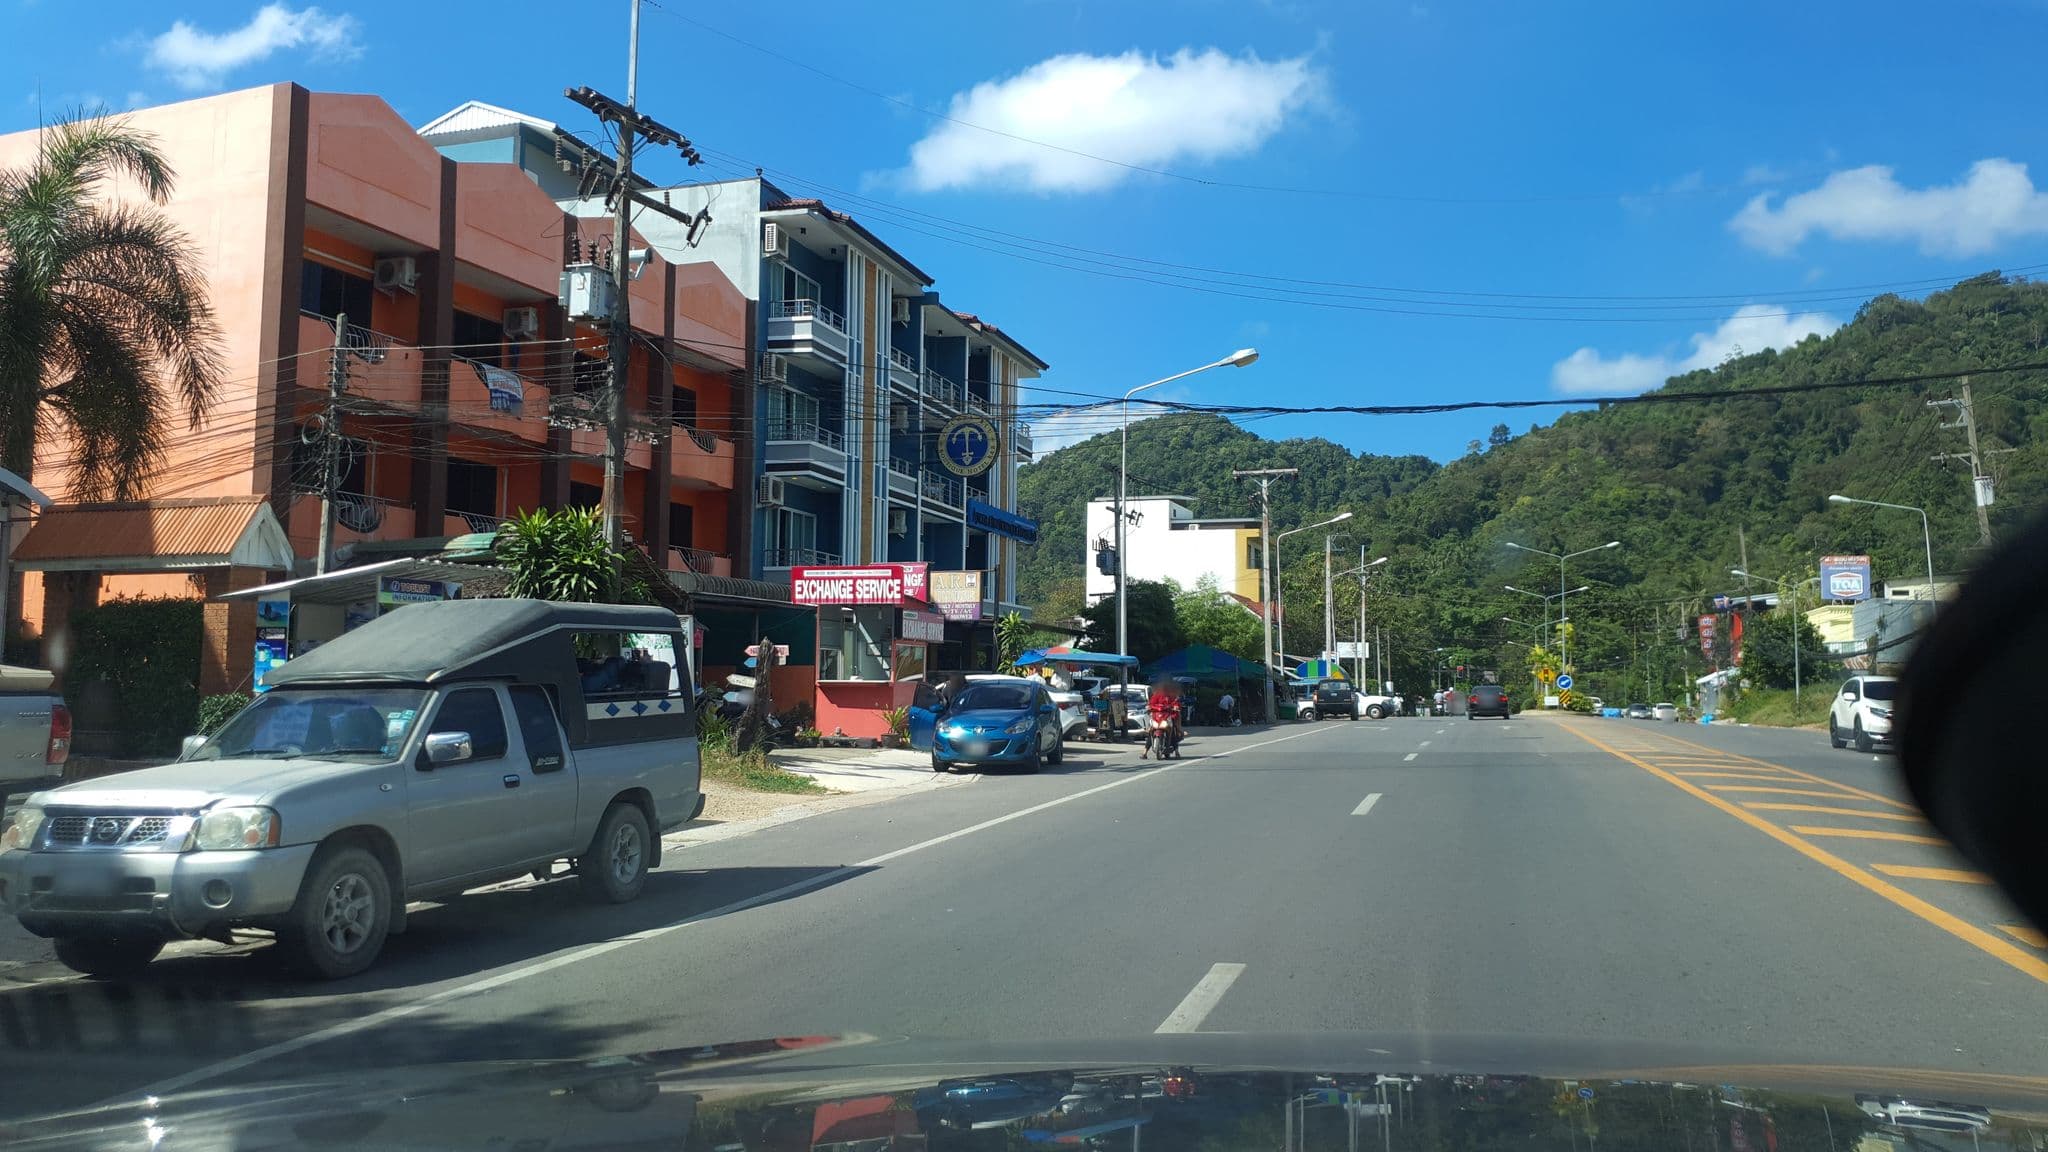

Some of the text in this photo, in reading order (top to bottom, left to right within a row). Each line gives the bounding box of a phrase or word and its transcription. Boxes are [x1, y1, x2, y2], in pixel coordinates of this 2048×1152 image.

[967, 461, 989, 474] HOTEL
[400, 582, 431, 593] TOURIST
[795, 579, 901, 600] EXCHANGE SERVICE
[1831, 580, 1861, 590] TOA
[902, 619, 944, 642] EXCHANGE SERVICE
